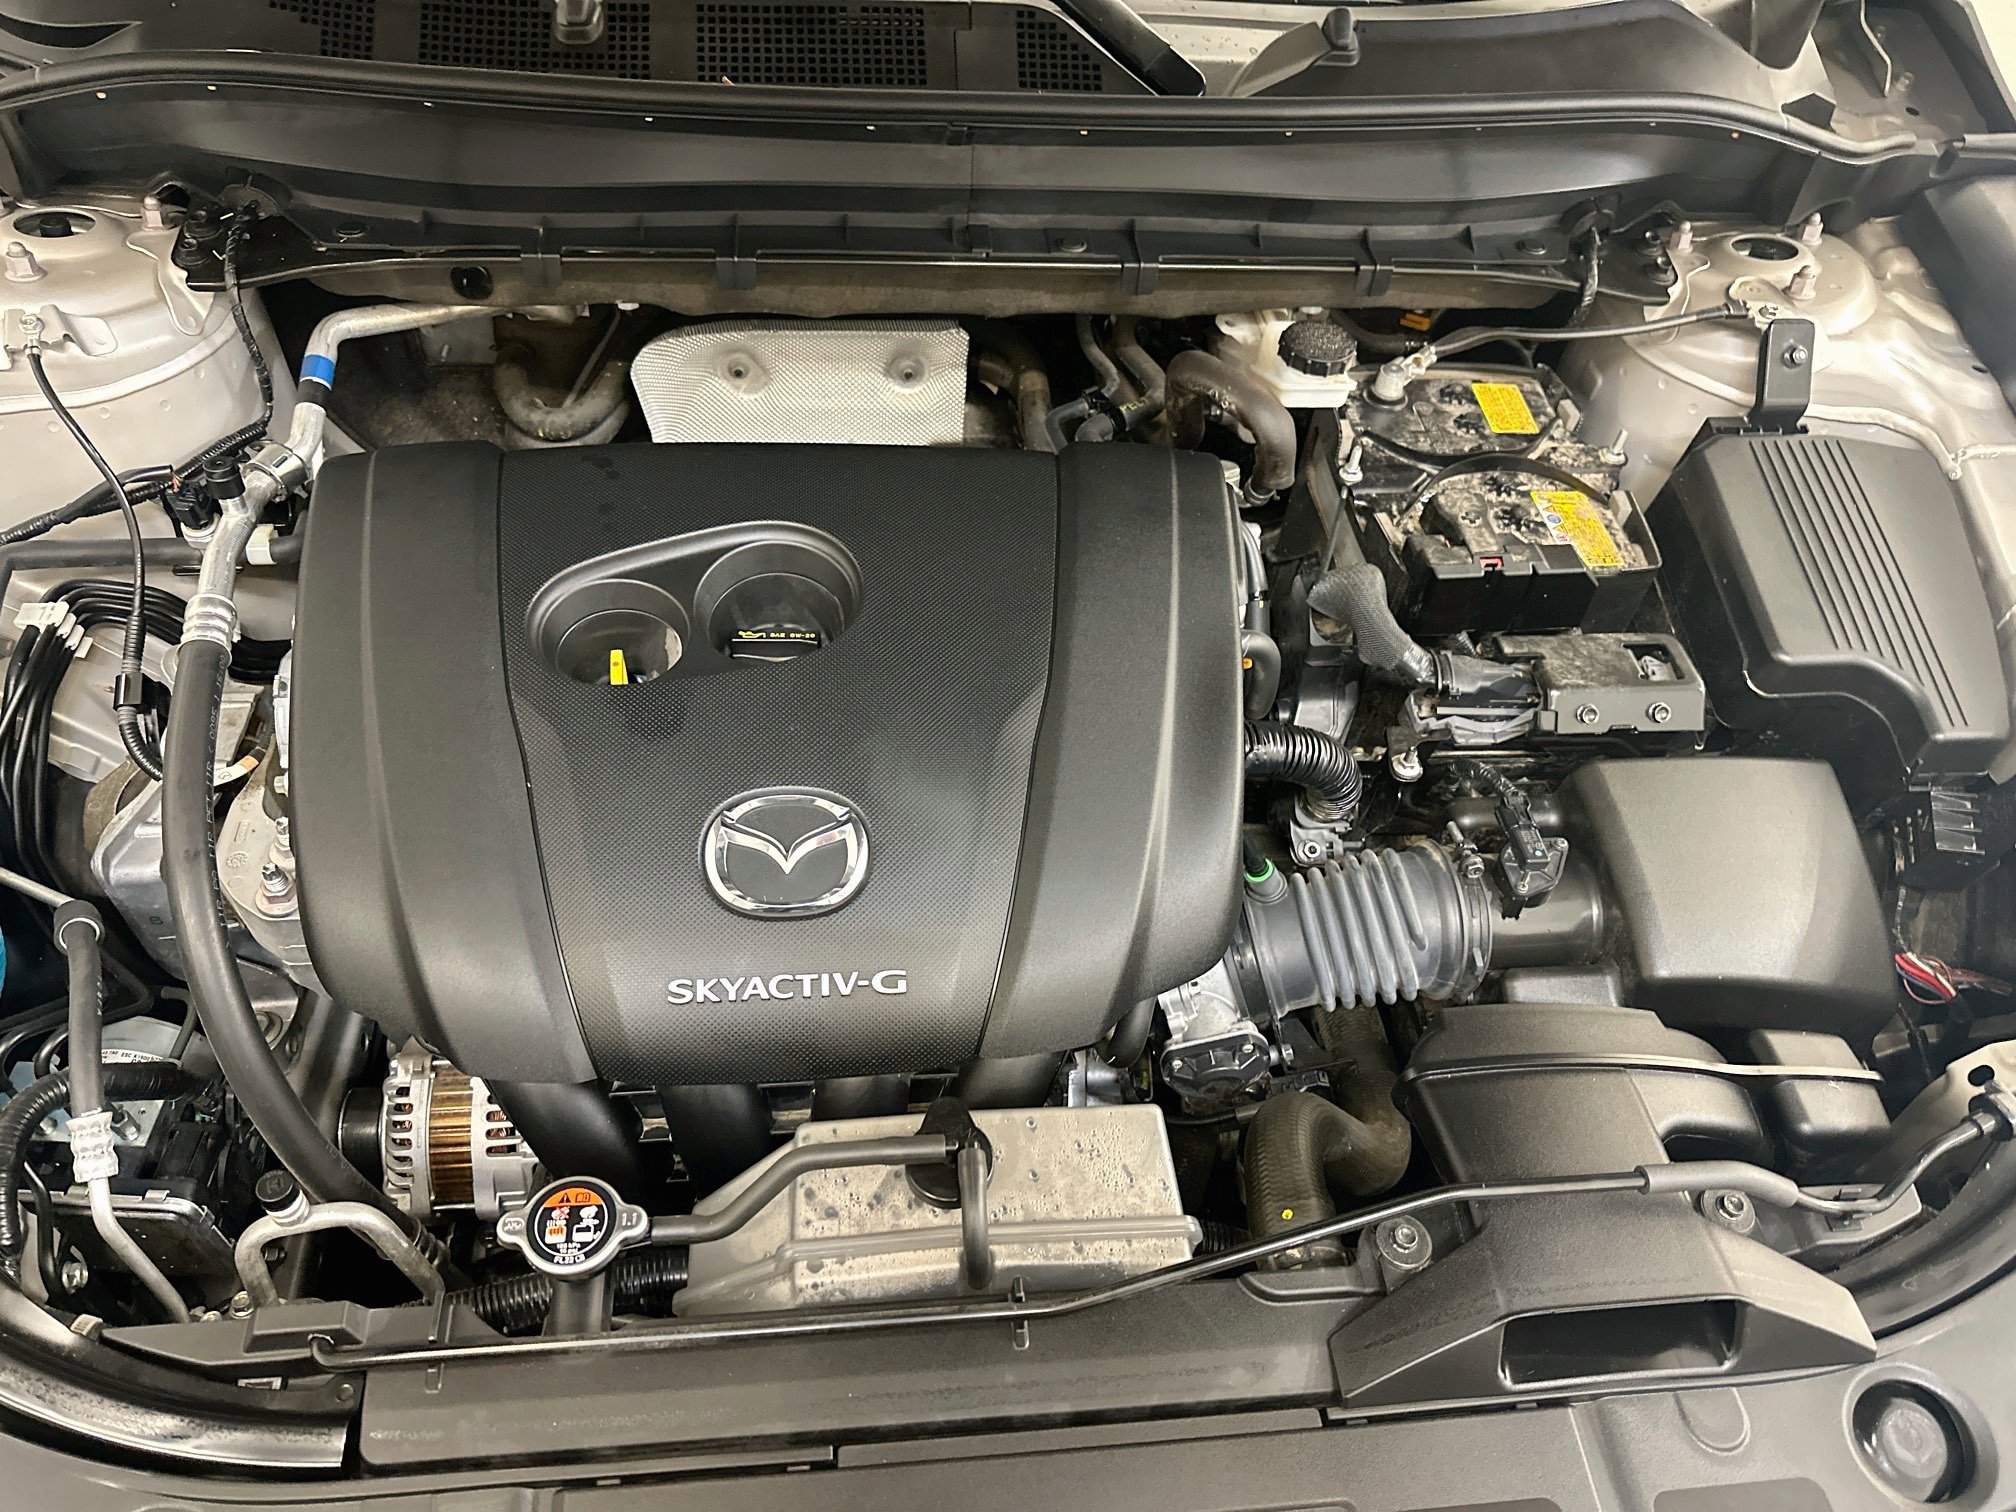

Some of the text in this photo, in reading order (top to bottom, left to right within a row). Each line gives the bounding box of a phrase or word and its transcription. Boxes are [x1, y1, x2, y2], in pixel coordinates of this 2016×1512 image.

[667, 969, 908, 1005] SKYACTIV-G
[622, 1212, 638, 1226] 1.1
[553, 1255, 575, 1265] FL22
